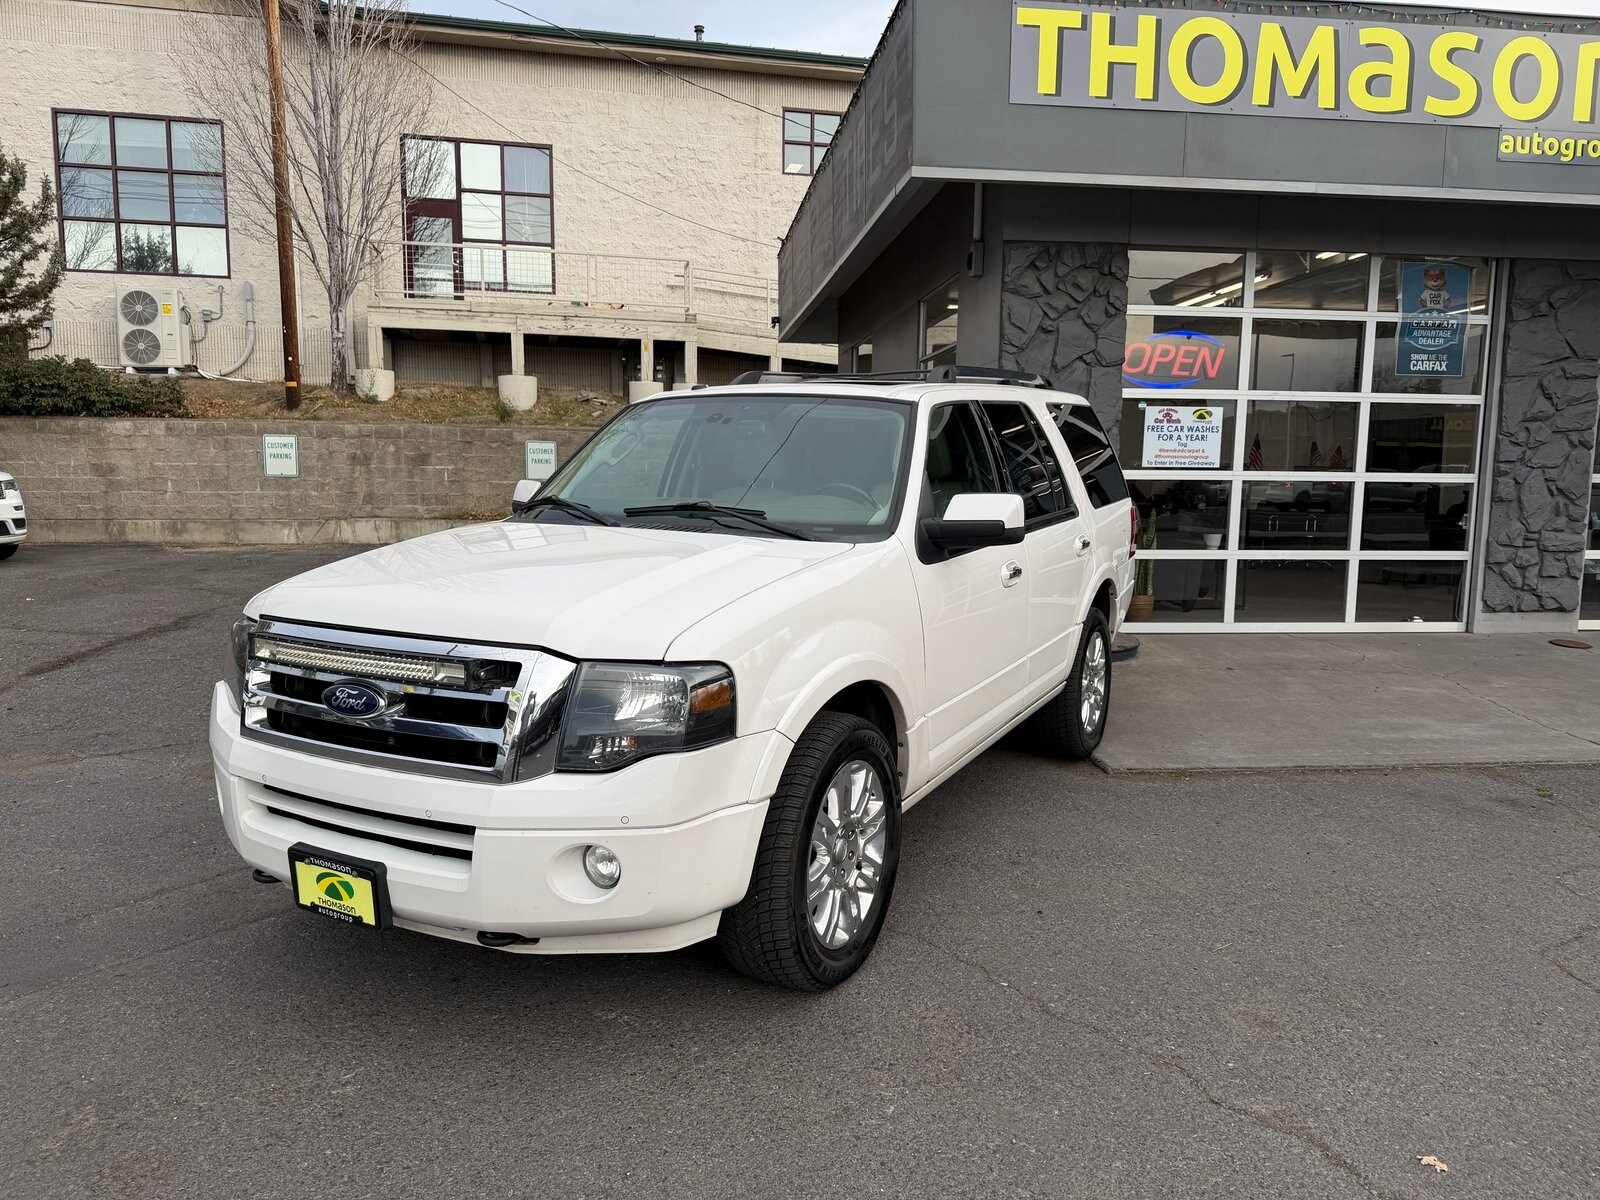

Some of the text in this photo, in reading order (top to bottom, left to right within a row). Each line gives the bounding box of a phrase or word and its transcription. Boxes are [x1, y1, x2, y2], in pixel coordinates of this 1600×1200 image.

[1412, 320, 1457, 328] CARFAX
[1412, 329, 1452, 338] ADVANTAGE
[1418, 337, 1444, 345] DEALER
[1122, 342, 1226, 378] OPEN
[1410, 353, 1429, 361] SHOW
[1410, 360, 1448, 371] CARFAX
[1147, 425, 1220, 433] FREE CAR WASHES
[331, 687, 367, 710] Ford
[318, 907, 353, 923] autogroup
